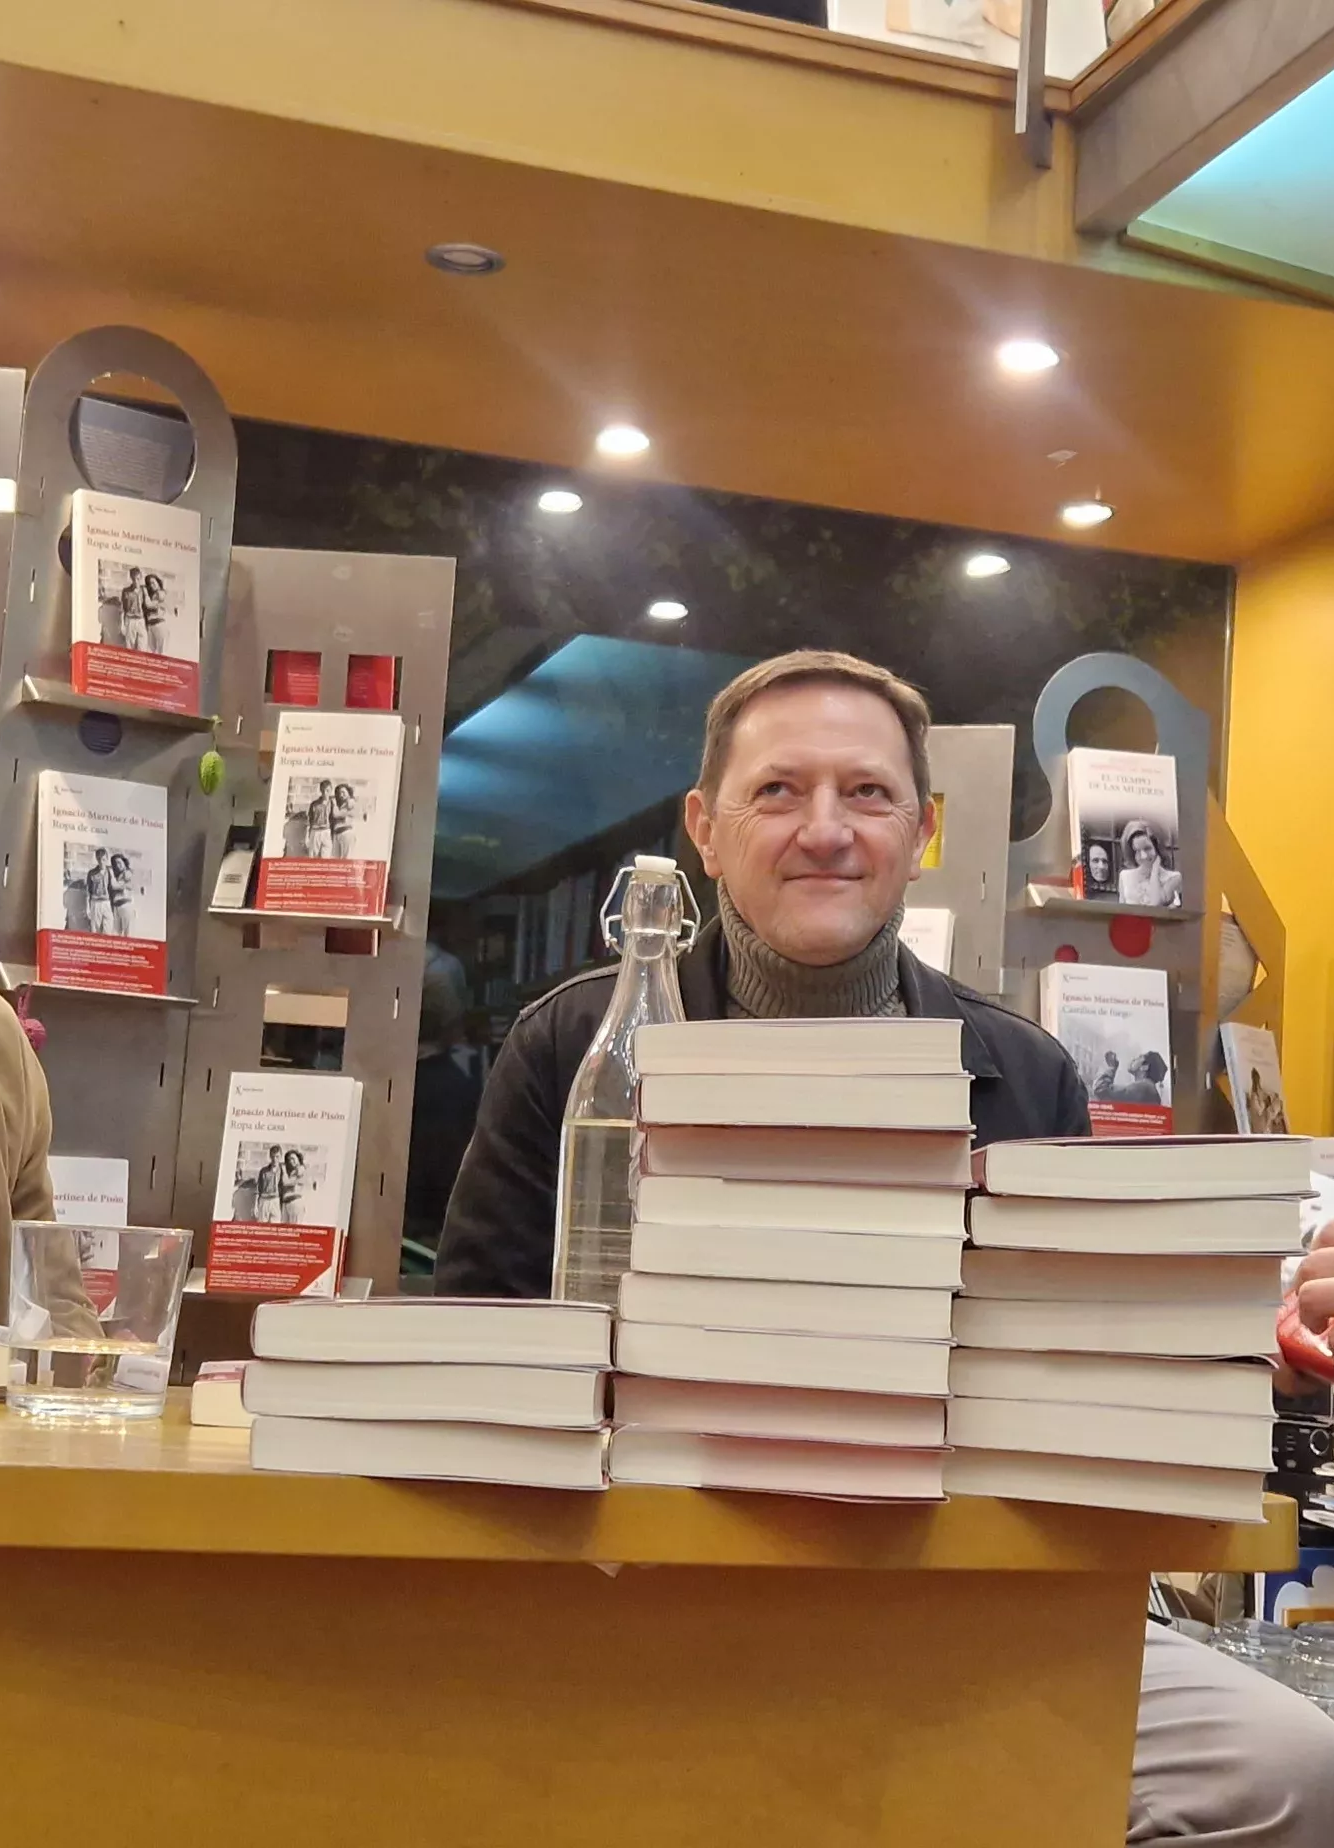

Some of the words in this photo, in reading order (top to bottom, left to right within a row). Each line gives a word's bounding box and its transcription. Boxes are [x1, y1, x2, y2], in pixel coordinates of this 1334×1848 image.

[87, 525, 119, 538] Ignacio
[163, 537, 172, 547] de
[87, 537, 109, 551] Ropa
[112, 541, 122, 551] de
[124, 546, 142, 555] casa
[282, 744, 314, 755] Ignacio
[316, 744, 355, 755] Martínez
[357, 746, 367, 755] de
[370, 746, 394, 757] Pisón
[280, 756, 302, 767] Ropa
[304, 757, 315, 766] de
[317, 759, 335, 767] casa
[52, 806, 86, 818] Ignacio
[129, 816, 139, 826] de
[52, 820, 76, 832] Ropa
[78, 823, 88, 832] de
[90, 826, 108, 835] casa
[1062, 992, 1092, 1004] Ignacio
[1131, 997, 1142, 1006] de
[1098, 1006, 1107, 1016] de
[232, 1106, 264, 1119] Ignacio
[266, 1107, 306, 1119] Martínez
[308, 1110, 318, 1120] de
[320, 1110, 346, 1121] Pisón
[230, 1120, 253, 1132] Ropa
[254, 1121, 265, 1131] de
[267, 1124, 285, 1132] casa
[54, 1192, 85, 1201] artínez
[87, 1192, 97, 1203] de
[100, 1194, 124, 1204] Pisón
